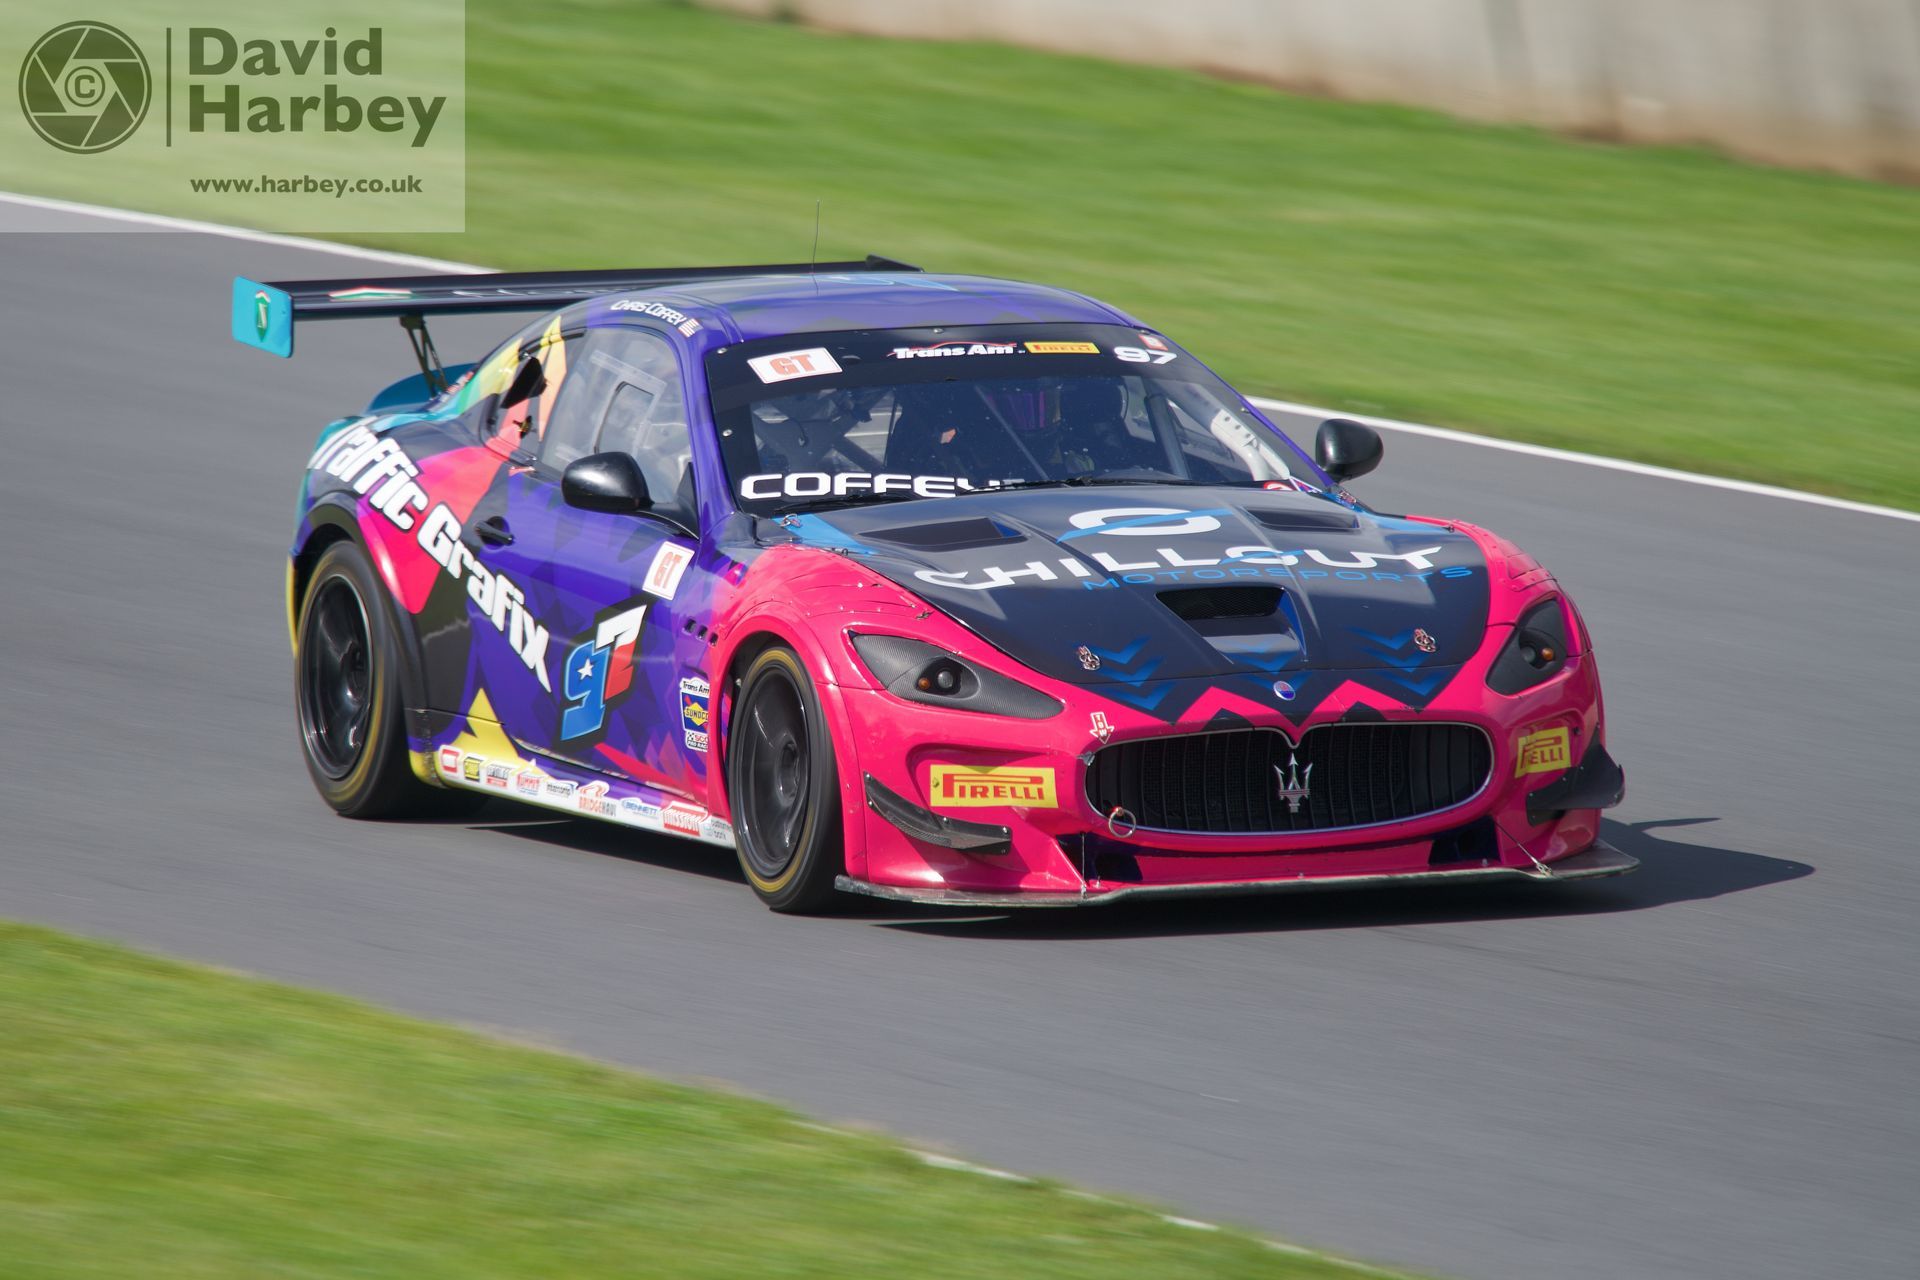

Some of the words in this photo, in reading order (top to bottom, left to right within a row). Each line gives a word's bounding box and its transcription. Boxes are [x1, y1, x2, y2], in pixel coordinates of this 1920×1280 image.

[893, 346, 965, 359] Trans
[968, 344, 1014, 355] Am
[1033, 344, 1091, 352] PIRELLI
[1114, 346, 1177, 365] 97
[769, 354, 817, 376] GT
[653, 551, 682, 589] GT
[1082, 566, 1473, 590] MOTORSPORTS
[417, 503, 551, 693] Grafix
[561, 604, 647, 741] 97
[1096, 715, 1107, 737] TOW
[1520, 736, 1563, 769] PELLI
[942, 773, 1044, 800] PIRELLI
